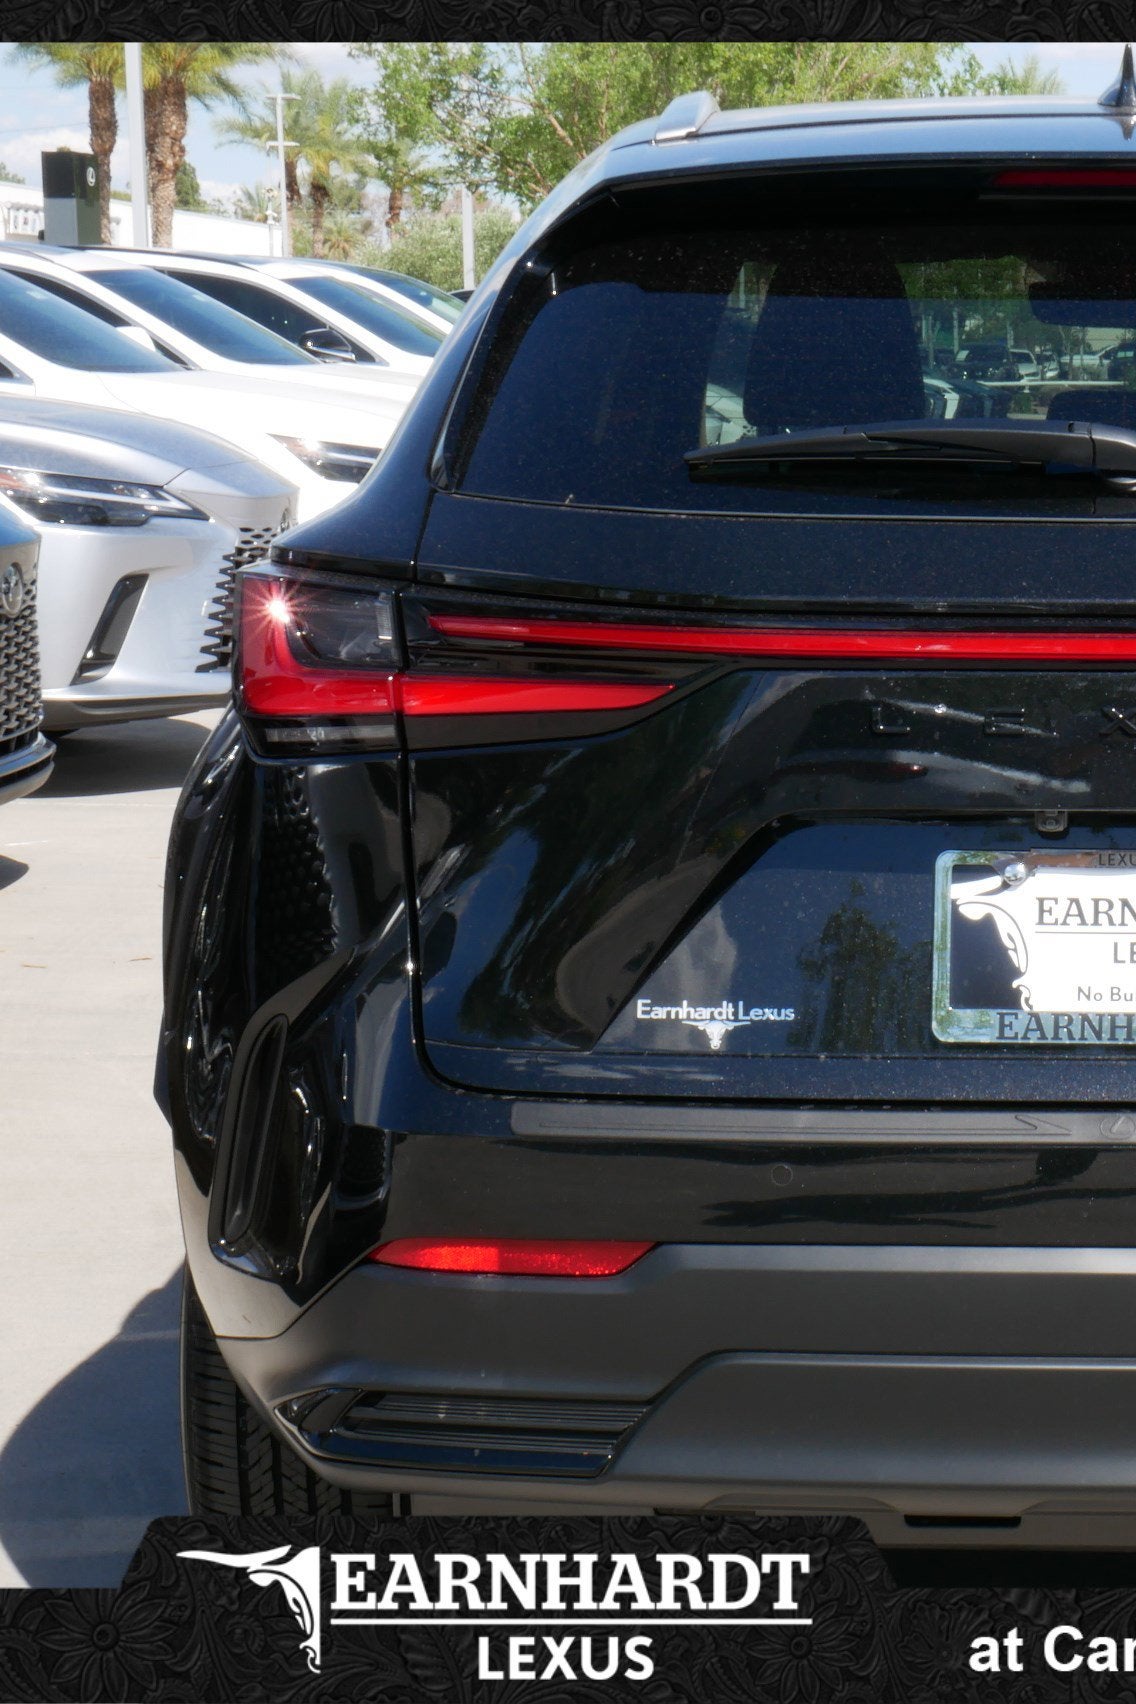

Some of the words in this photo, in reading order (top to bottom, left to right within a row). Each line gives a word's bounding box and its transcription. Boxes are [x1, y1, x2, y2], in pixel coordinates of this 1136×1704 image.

[1077, 986, 1103, 1002] No
[636, 998, 735, 1019] Earnhardt
[738, 1000, 796, 1021] Lexus
